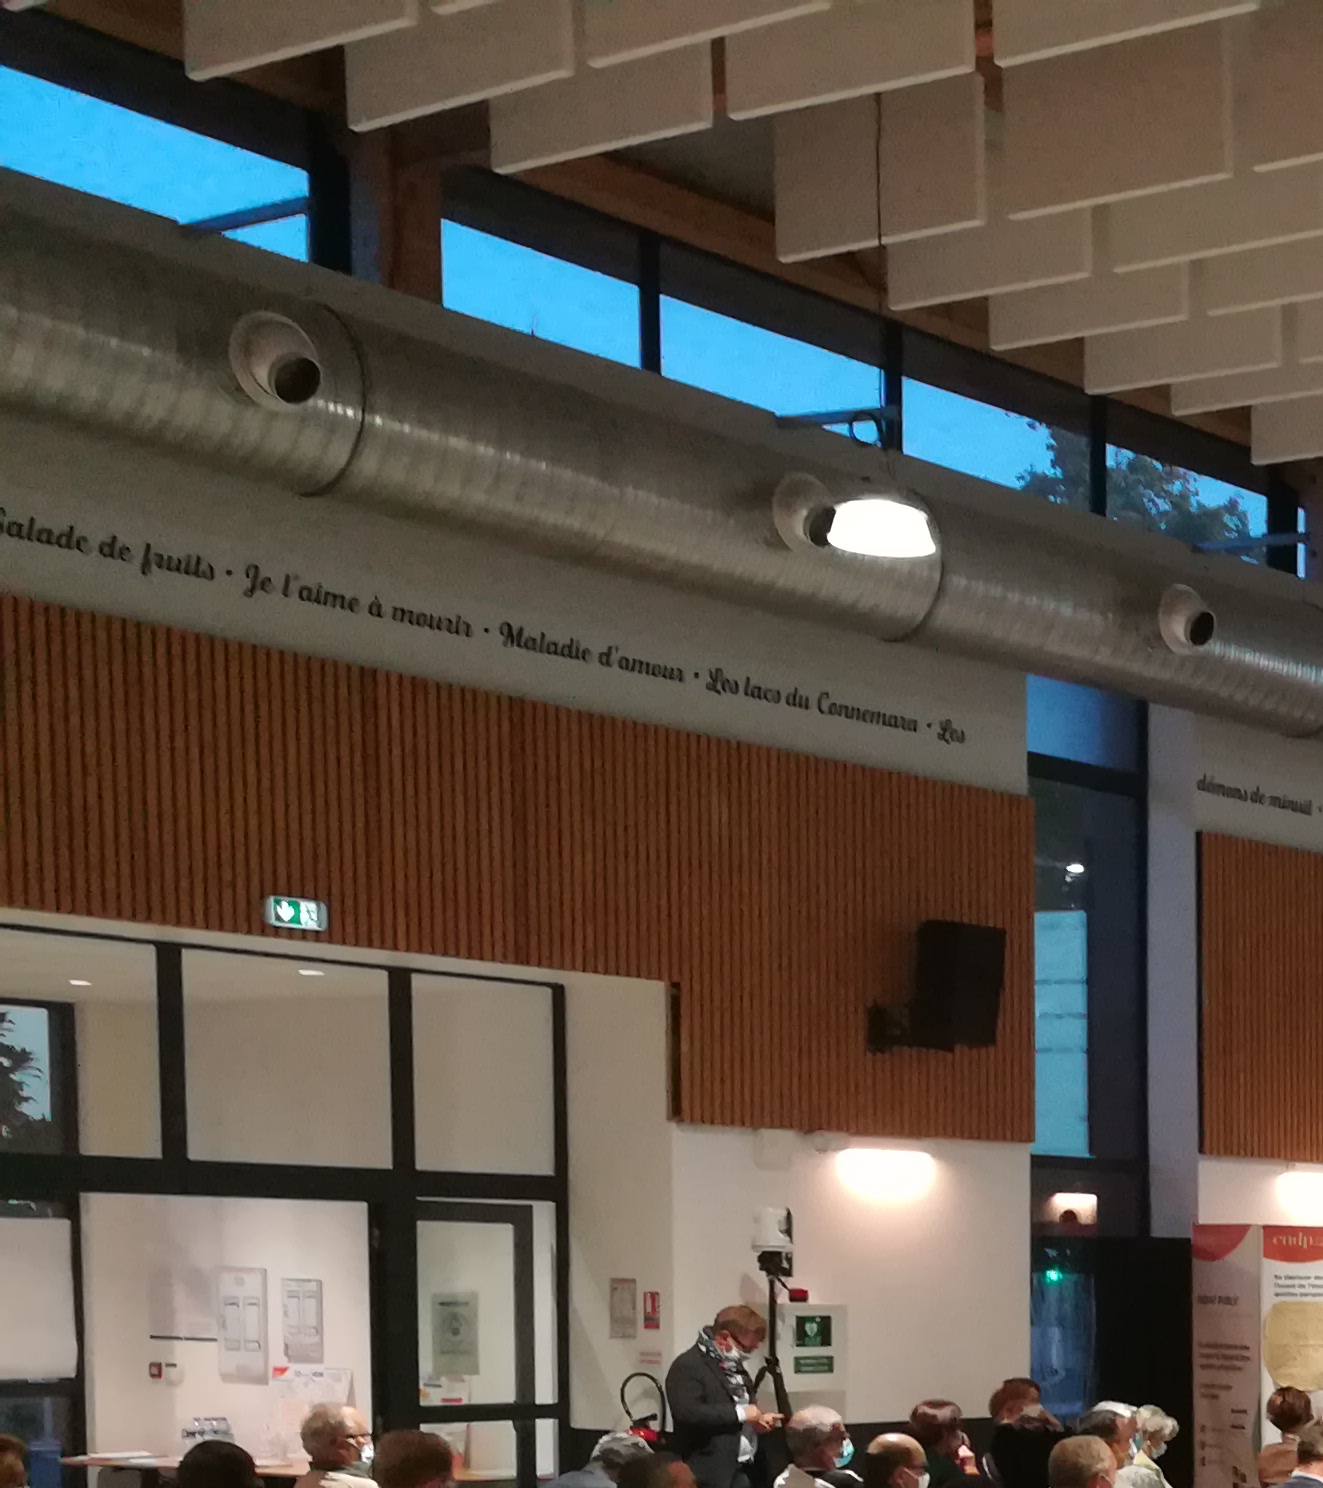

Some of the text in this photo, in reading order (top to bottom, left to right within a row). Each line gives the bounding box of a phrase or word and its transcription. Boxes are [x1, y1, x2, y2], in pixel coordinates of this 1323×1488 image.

[99, 535, 133, 561] de
[140, 542, 214, 581] fruits
[243, 563, 276, 598] Je
[368, 594, 384, 618] à
[392, 604, 474, 638] mourir
[499, 621, 592, 662] Maladie
[598, 645, 684, 682] d'amour
[706, 667, 740, 695] Les
[744, 676, 781, 704] lacs
[785, 687, 811, 710] du
[817, 692, 919, 733] Connemara
[937, 718, 967, 745] Les
[1250, 785, 1265, 805] de
